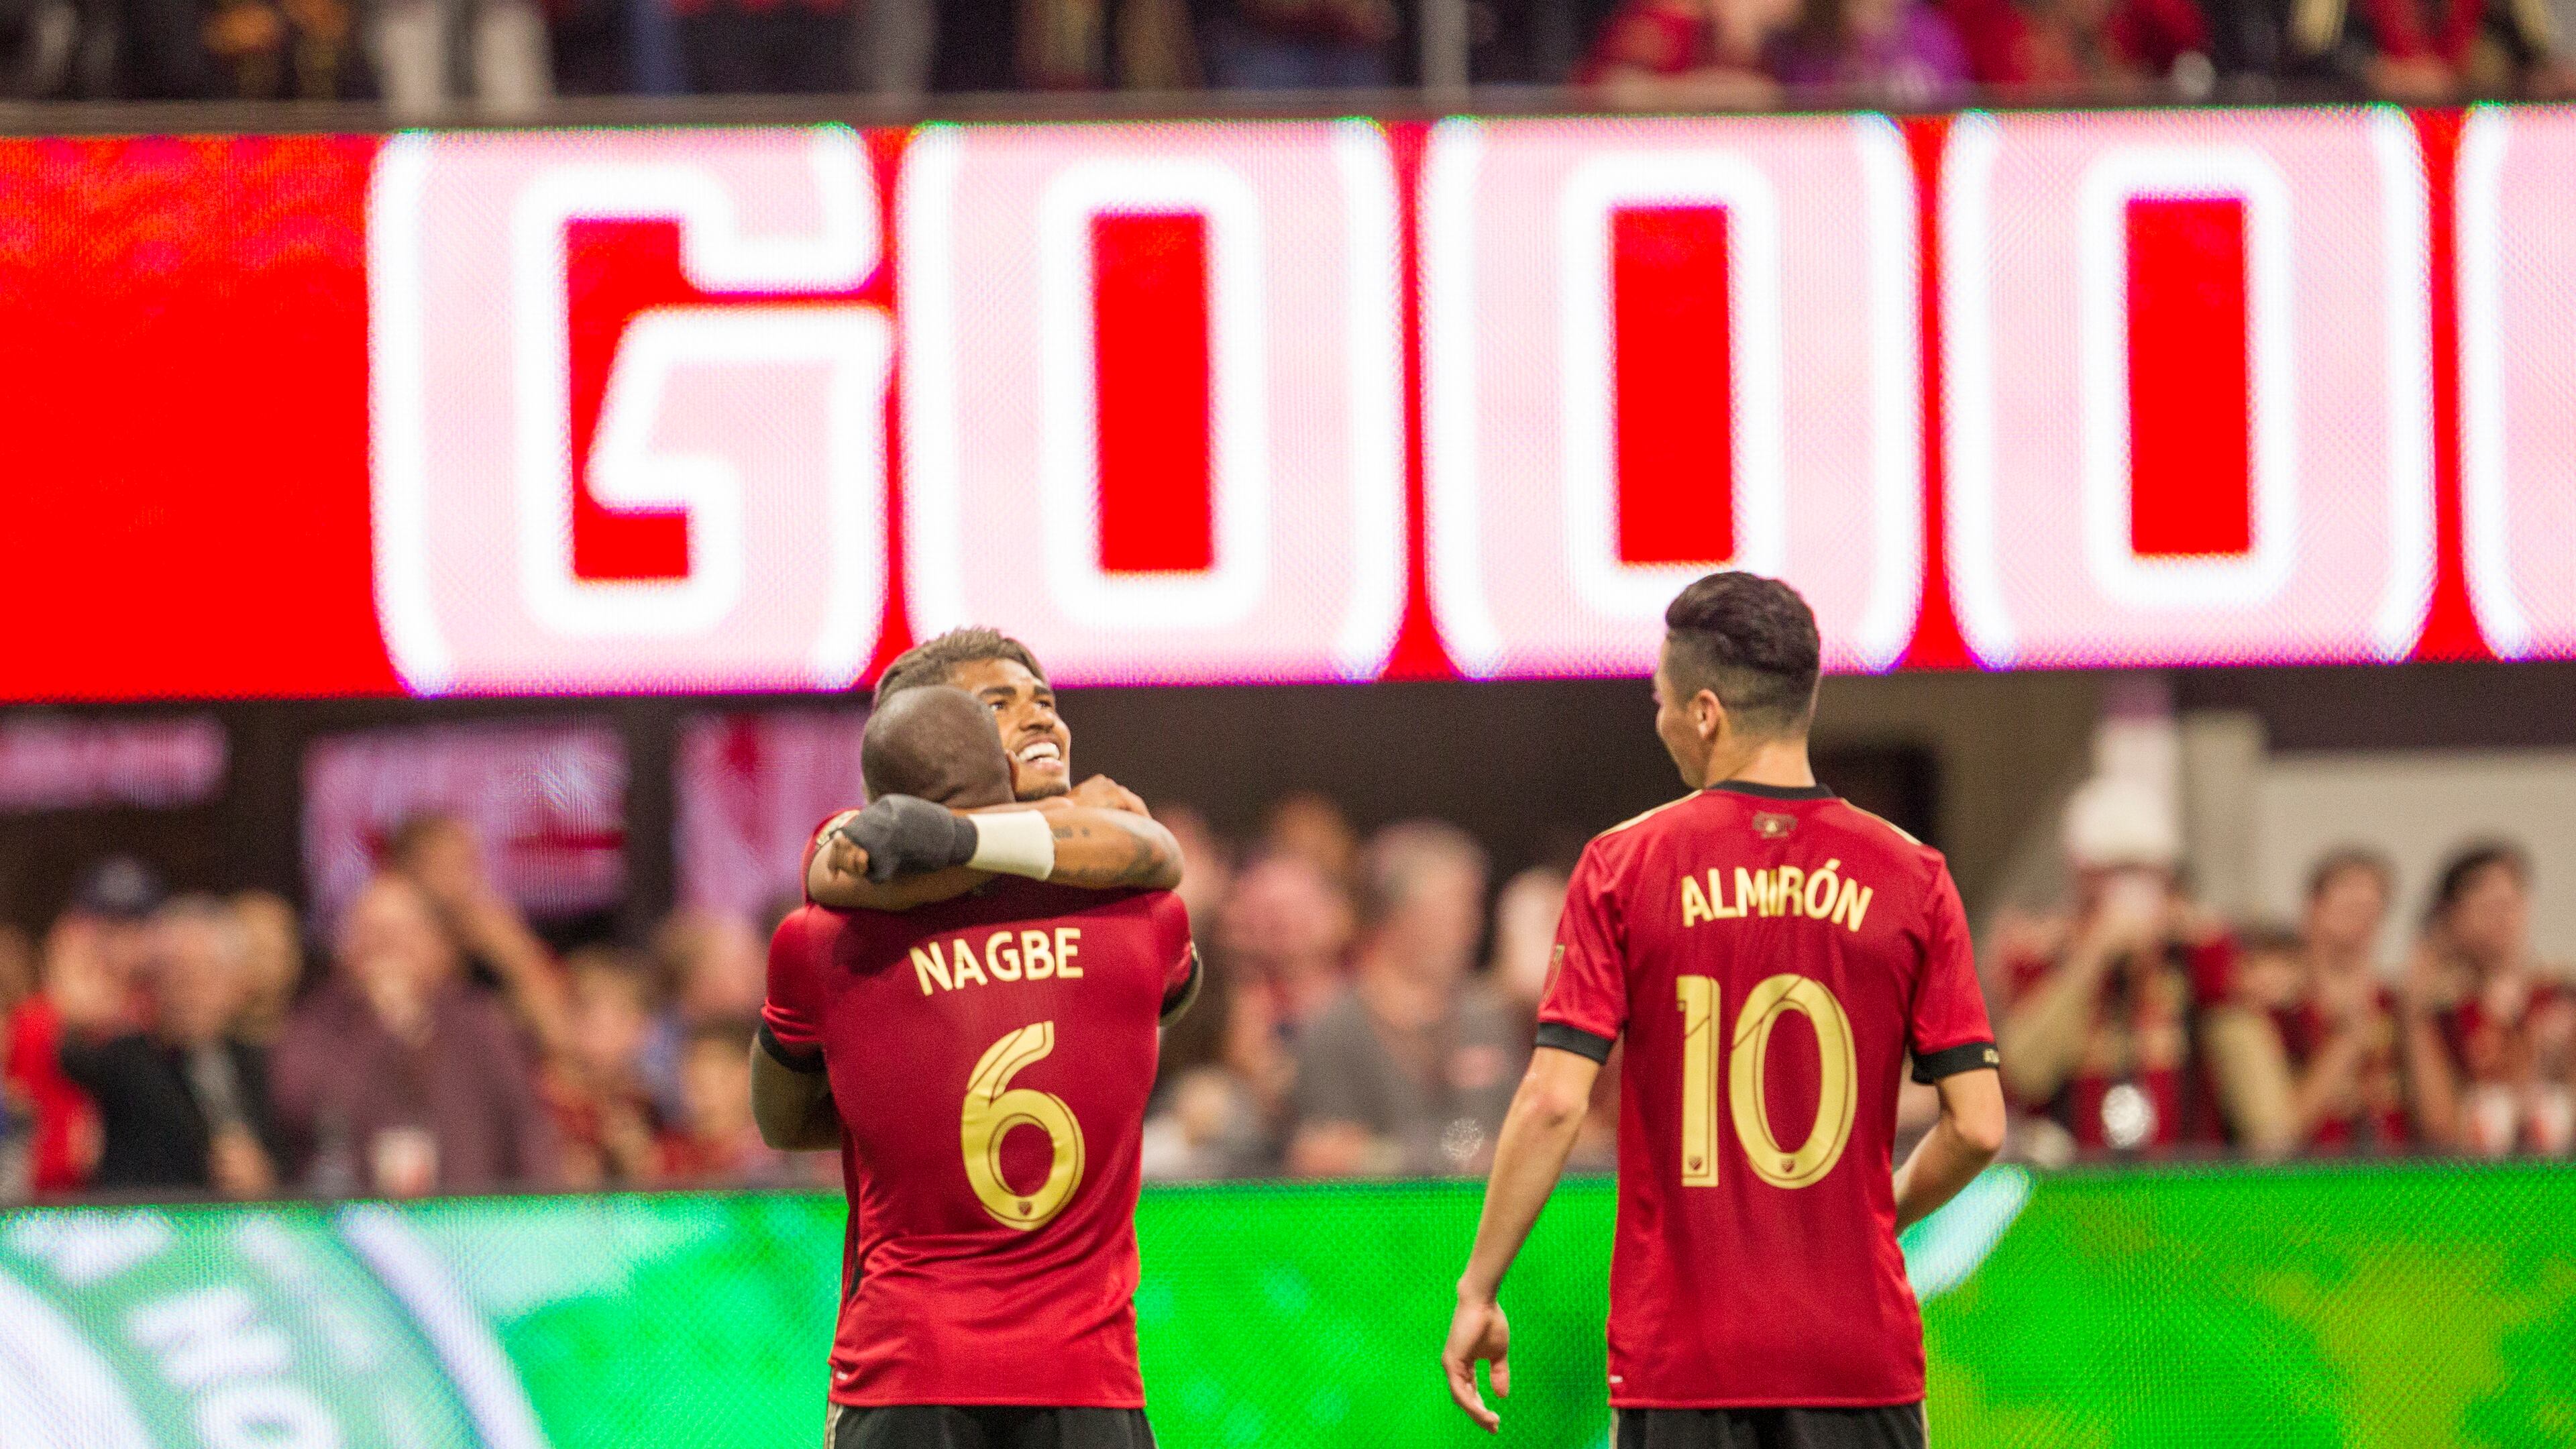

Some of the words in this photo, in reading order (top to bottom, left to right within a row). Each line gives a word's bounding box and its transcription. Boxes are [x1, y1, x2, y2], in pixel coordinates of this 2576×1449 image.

[366, 103, 2576, 696] GOOO
[910, 928, 1083, 996] NAGBE
[1681, 858, 1874, 932] ALMIRÓN
[961, 1020, 1085, 1231] 6
[1676, 973, 1858, 1189] 10
